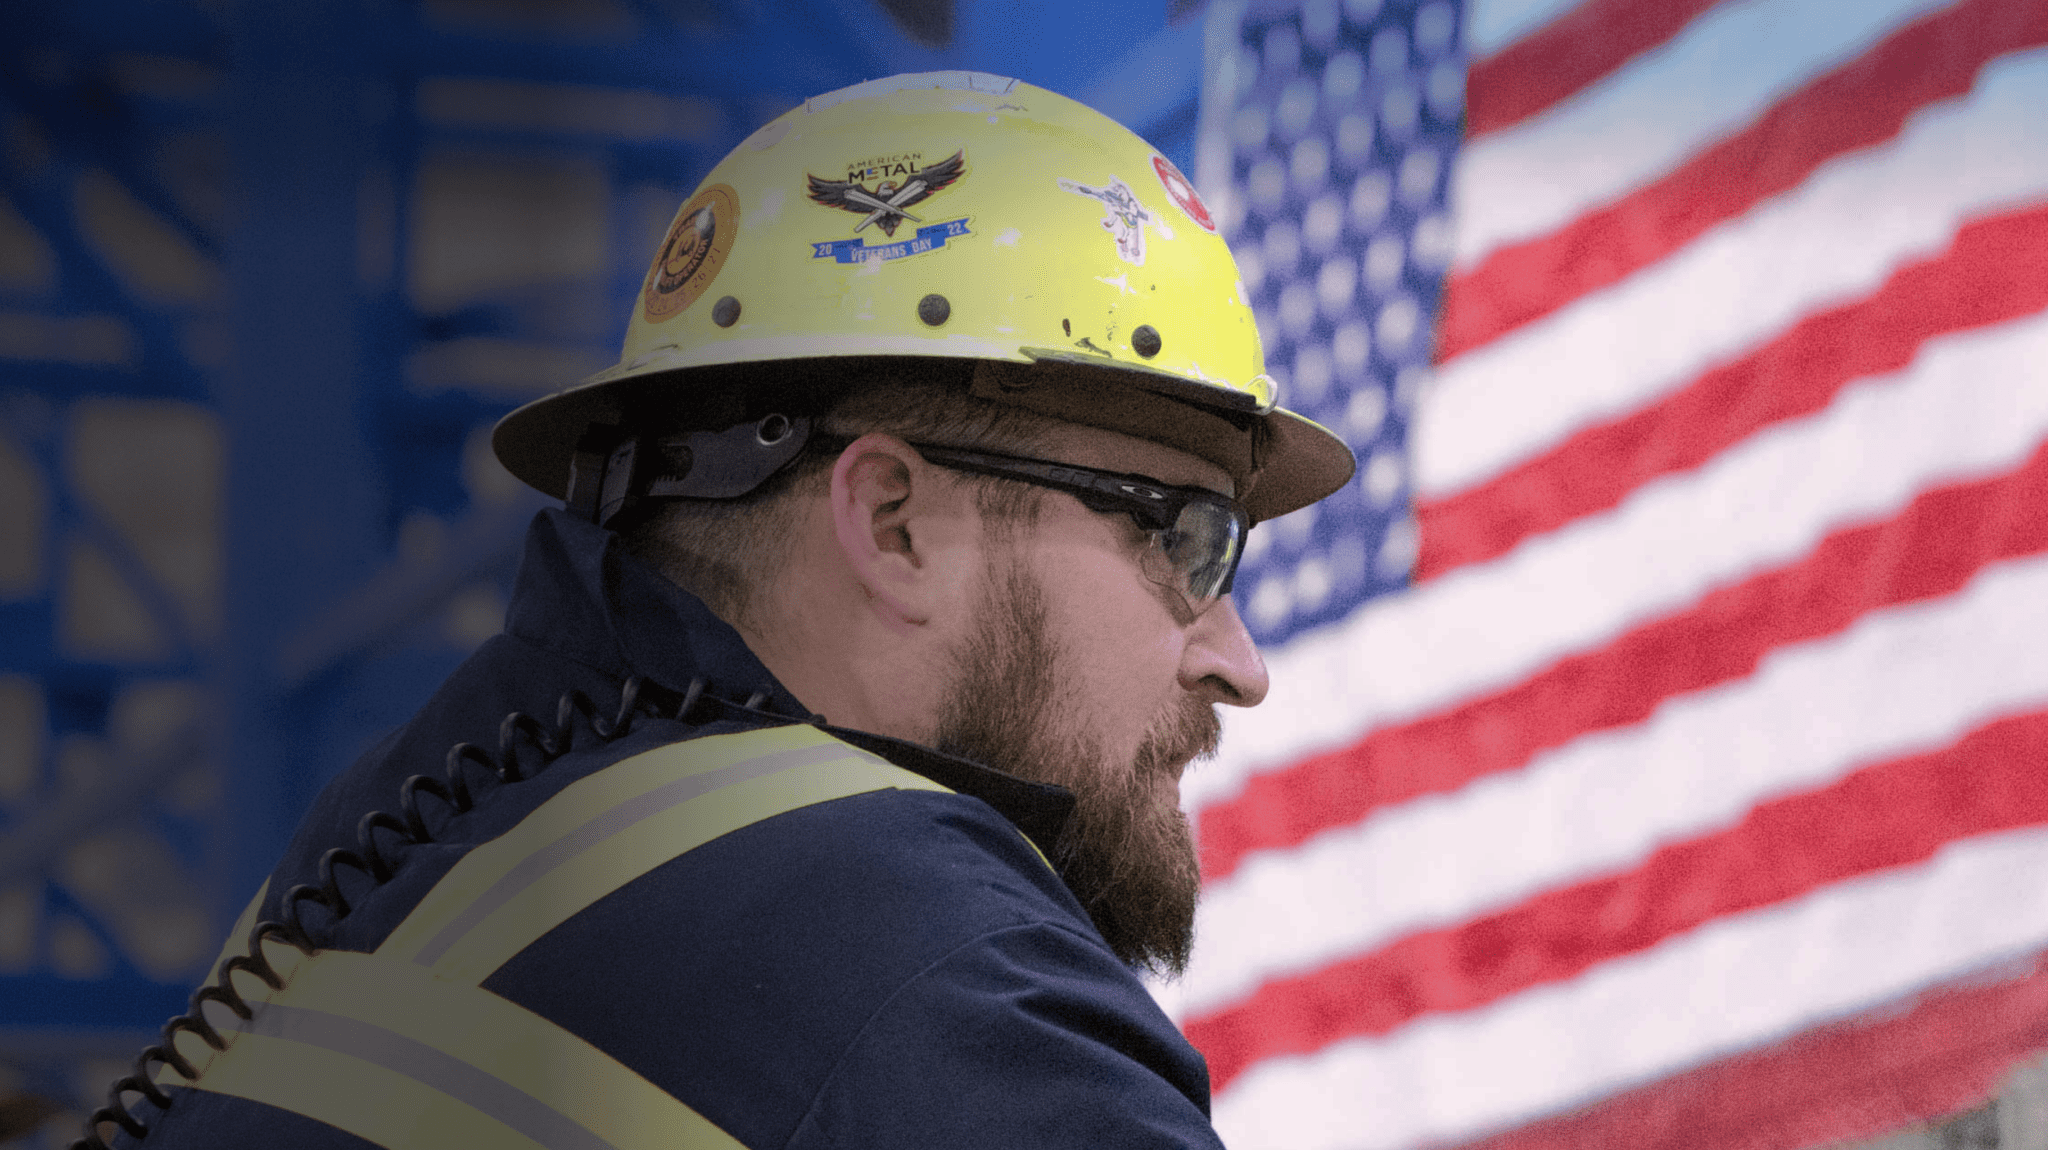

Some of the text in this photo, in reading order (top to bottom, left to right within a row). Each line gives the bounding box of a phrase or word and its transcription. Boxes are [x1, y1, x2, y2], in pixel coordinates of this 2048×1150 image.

[847, 153, 921, 170] AMERICAN
[849, 162, 920, 183] METAL
[818, 222, 963, 261] 20 VETERANS DAY 22
